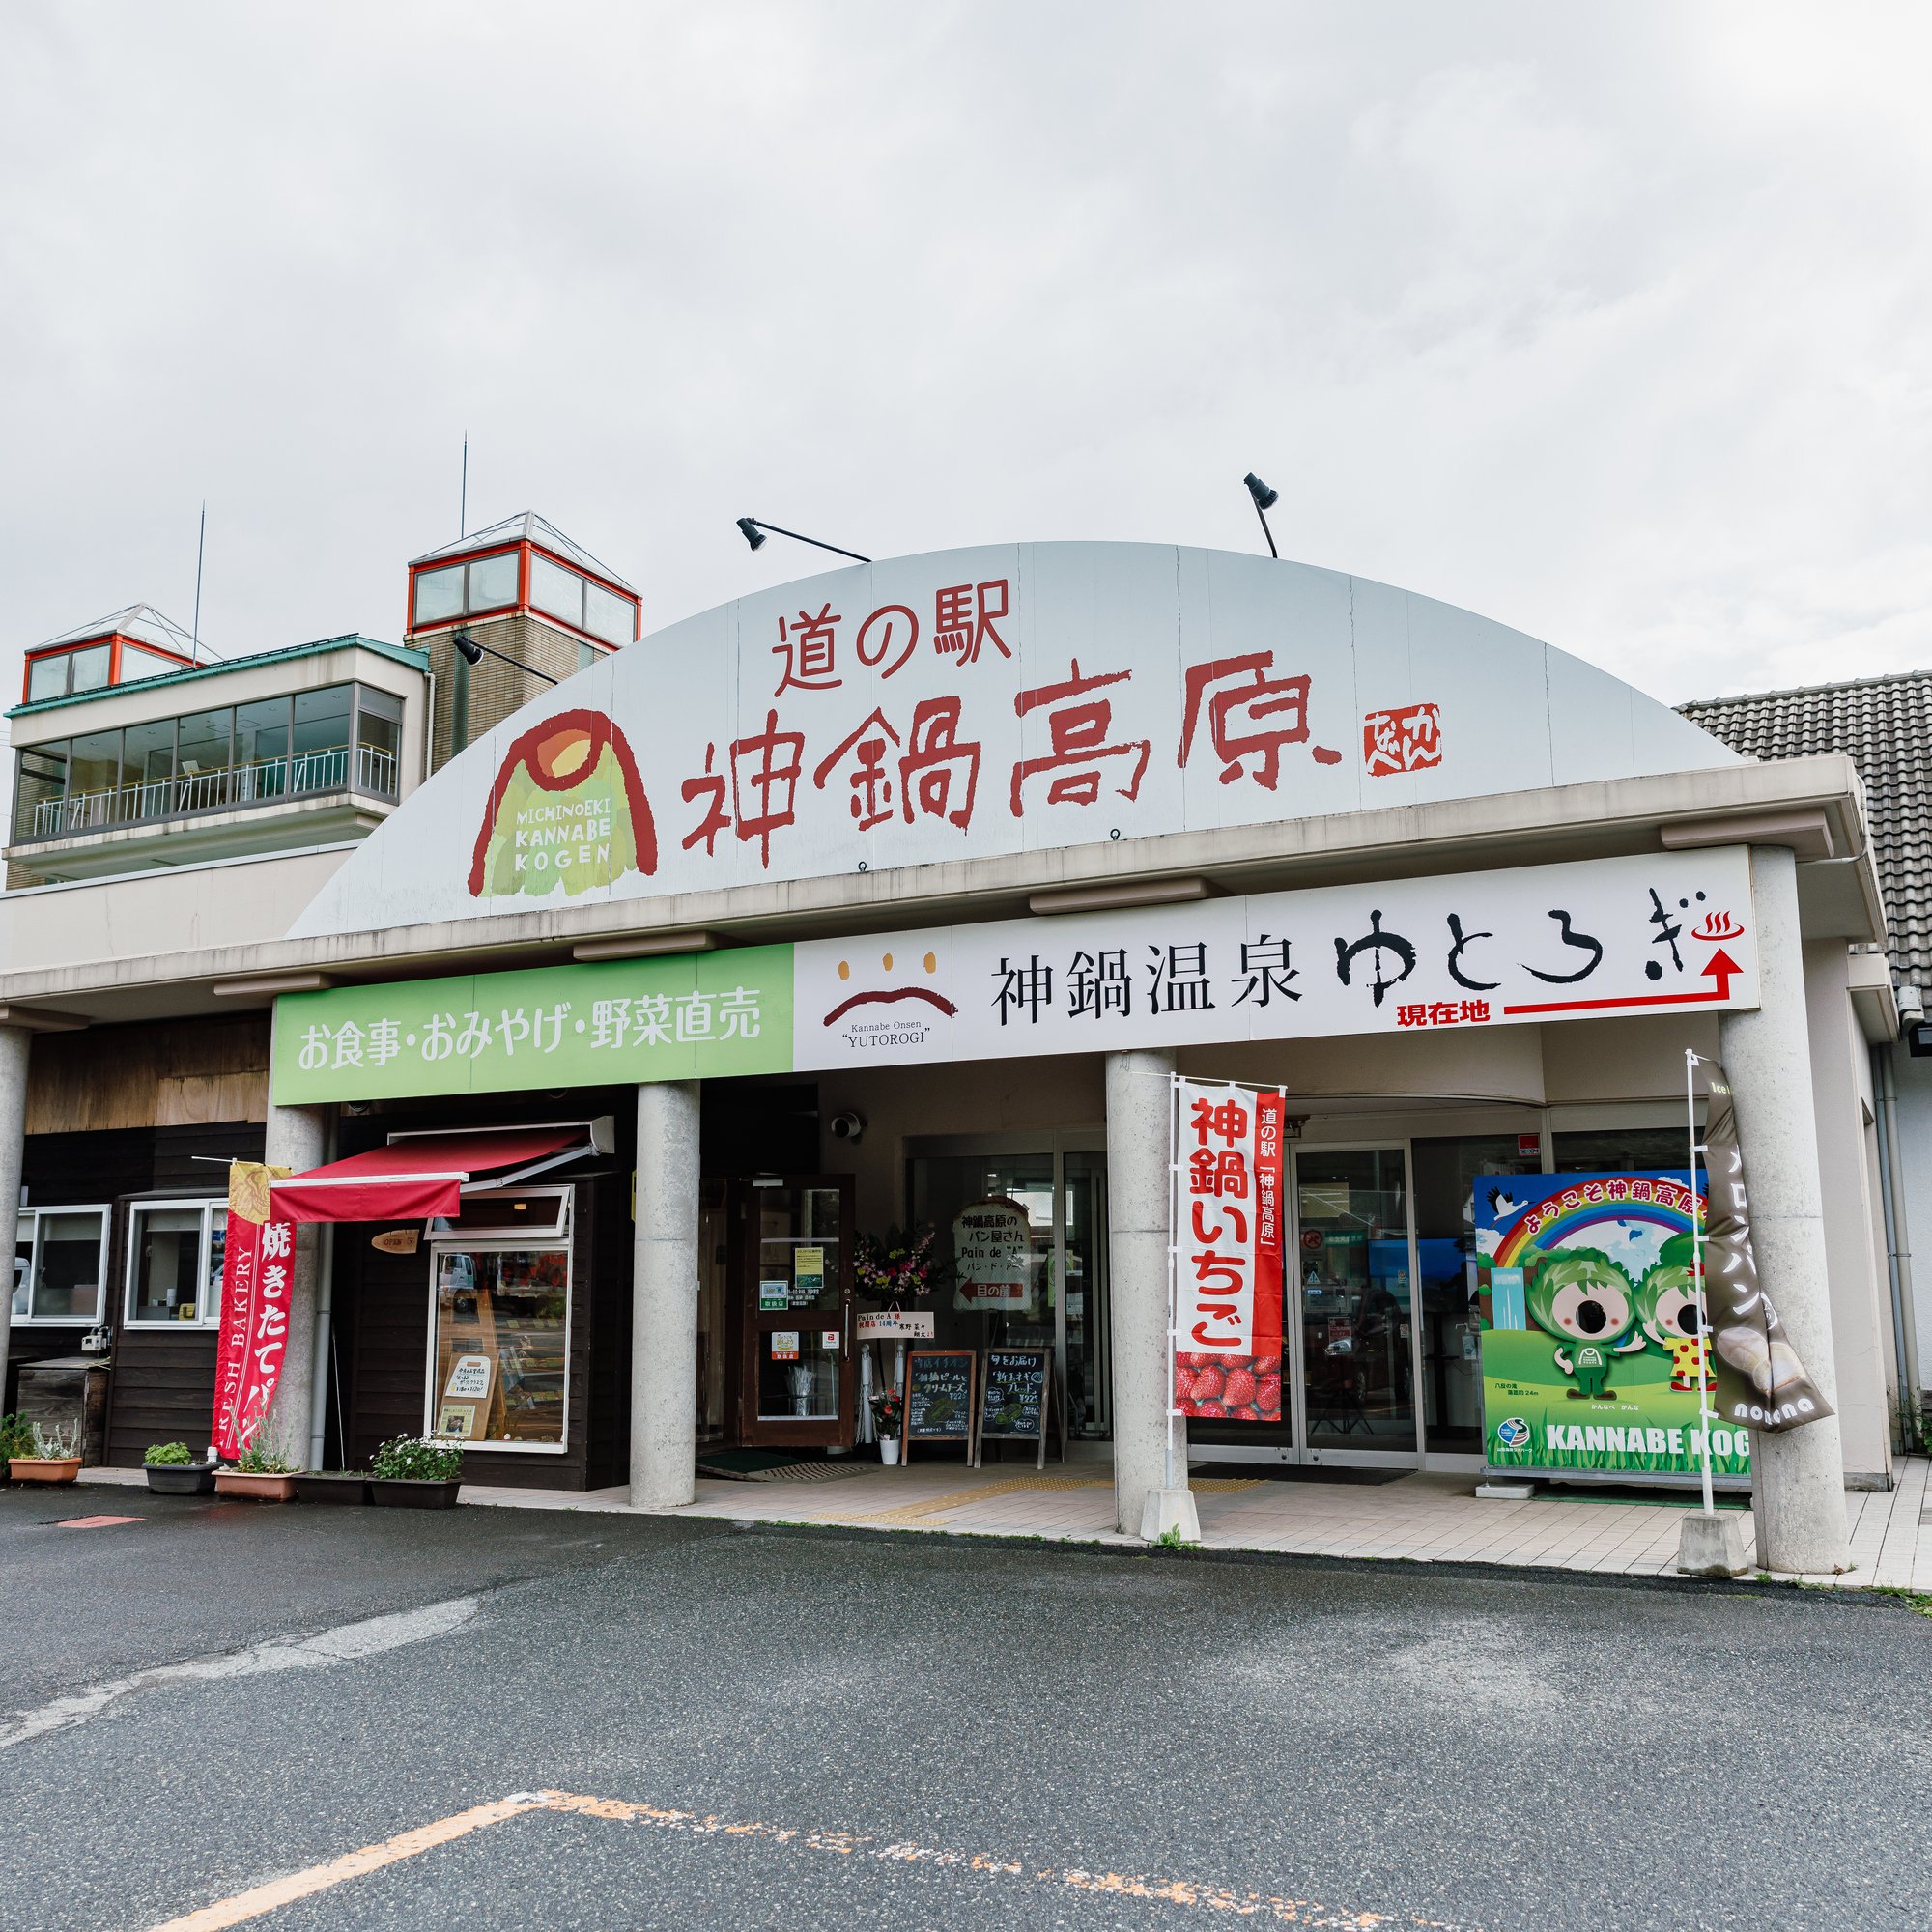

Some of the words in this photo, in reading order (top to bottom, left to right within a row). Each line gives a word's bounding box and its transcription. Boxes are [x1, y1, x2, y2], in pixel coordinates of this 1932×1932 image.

[772, 578, 1012, 697] 道の駅
[681, 649, 1342, 869] 神鍋高原
[516, 797, 611, 825] MICHINOEKI
[515, 818, 611, 847] KANNABE
[515, 843, 610, 871] KOGEN
[991, 934, 1303, 1026] 神鍋温泉
[1334, 887, 1706, 1008] ゆとろぎ
[298, 986, 760, 1069] お食事・おみやげ・野菜直売
[851, 1022, 890, 1033] Kannabe
[894, 1021, 922, 1030] Onsen
[1397, 999, 1491, 1027] 現在地
[1260, 1108, 1277, 1157] 道の駅
[961, 1215, 1017, 1229] 神鍋高原の
[1189, 1097, 1248, 1347] 神鍋いちご
[1524, 1179, 1708, 1236] ようこそ神鍋高原
[961, 1247, 984, 1258] Pain
[990, 1247, 1002, 1258] de
[232, 1247, 252, 1348] BAKERY
[977, 1284, 1010, 1297] 目の前
[991, 1354, 1037, 1367] 旬をお届け
[1547, 1424, 1685, 1455] KANNABE
